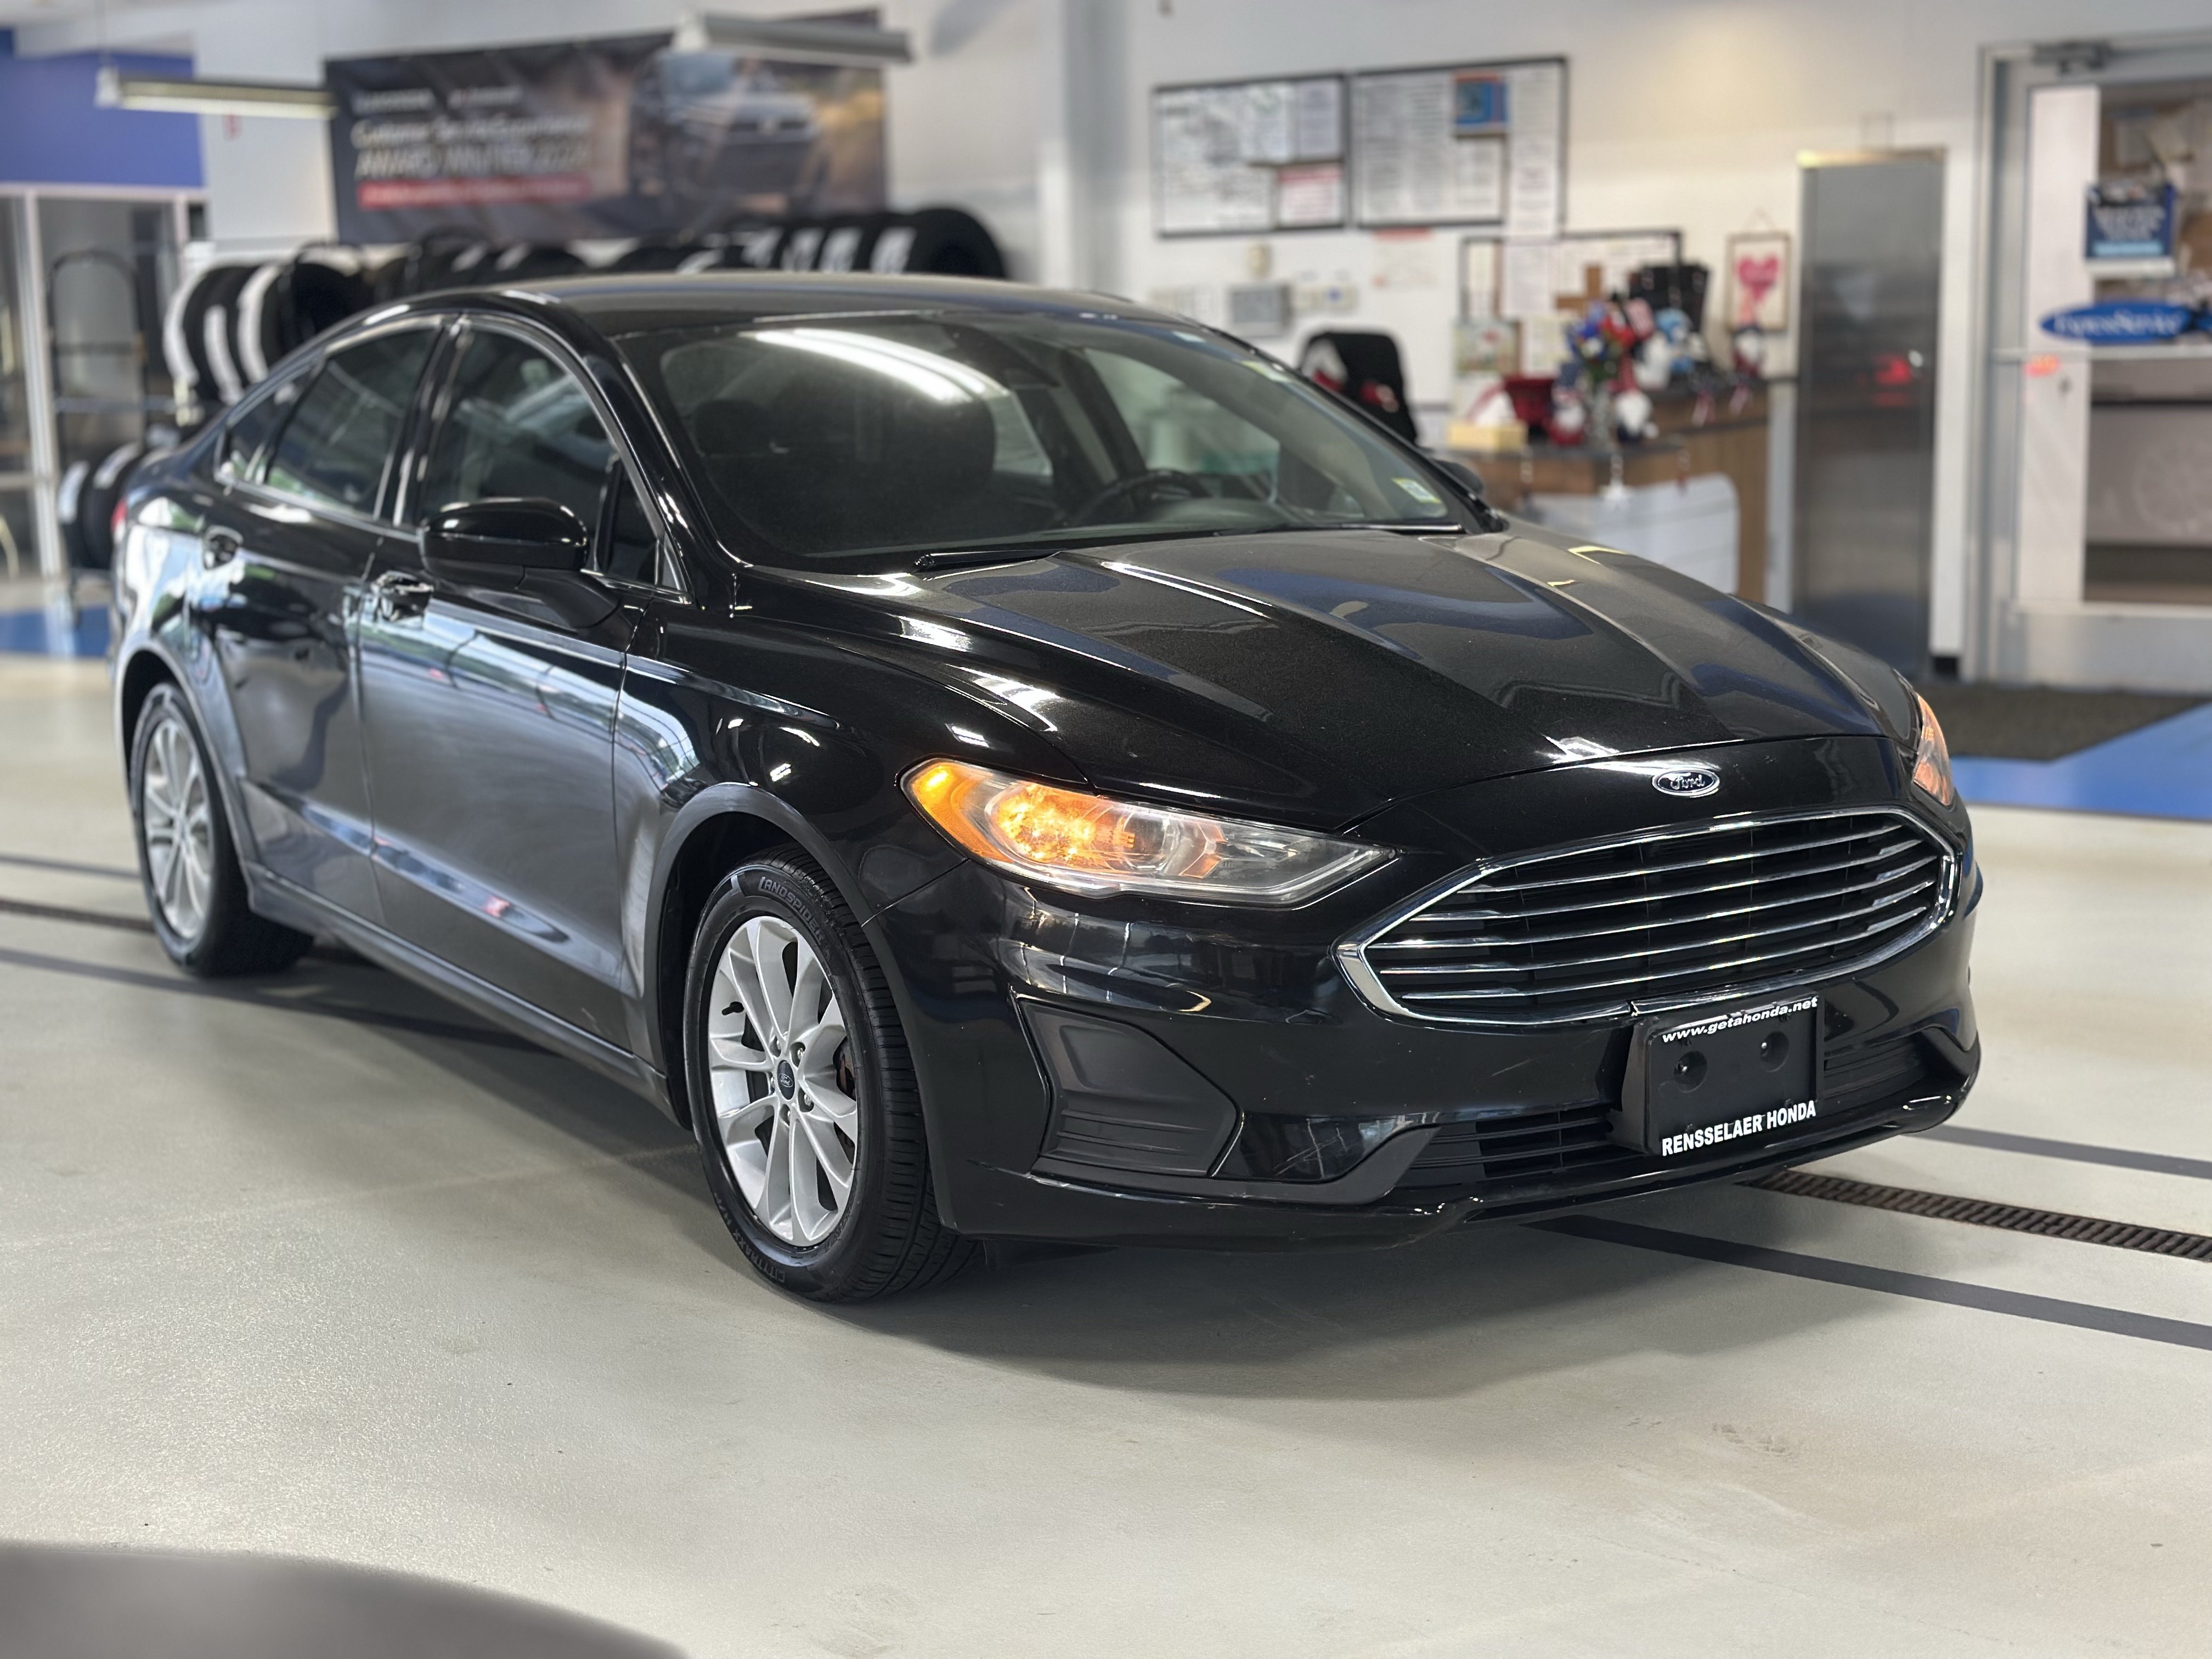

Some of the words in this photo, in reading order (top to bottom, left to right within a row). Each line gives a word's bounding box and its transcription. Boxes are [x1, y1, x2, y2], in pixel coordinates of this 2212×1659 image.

[1670, 772, 1705, 789] Ford
[758, 876, 825, 942] LANDSPIDER
[1662, 997, 1818, 1043] www.getahonda.net
[1662, 1114, 1762, 1156] RENSSELAER
[1767, 1100, 1816, 1130] HONDA
